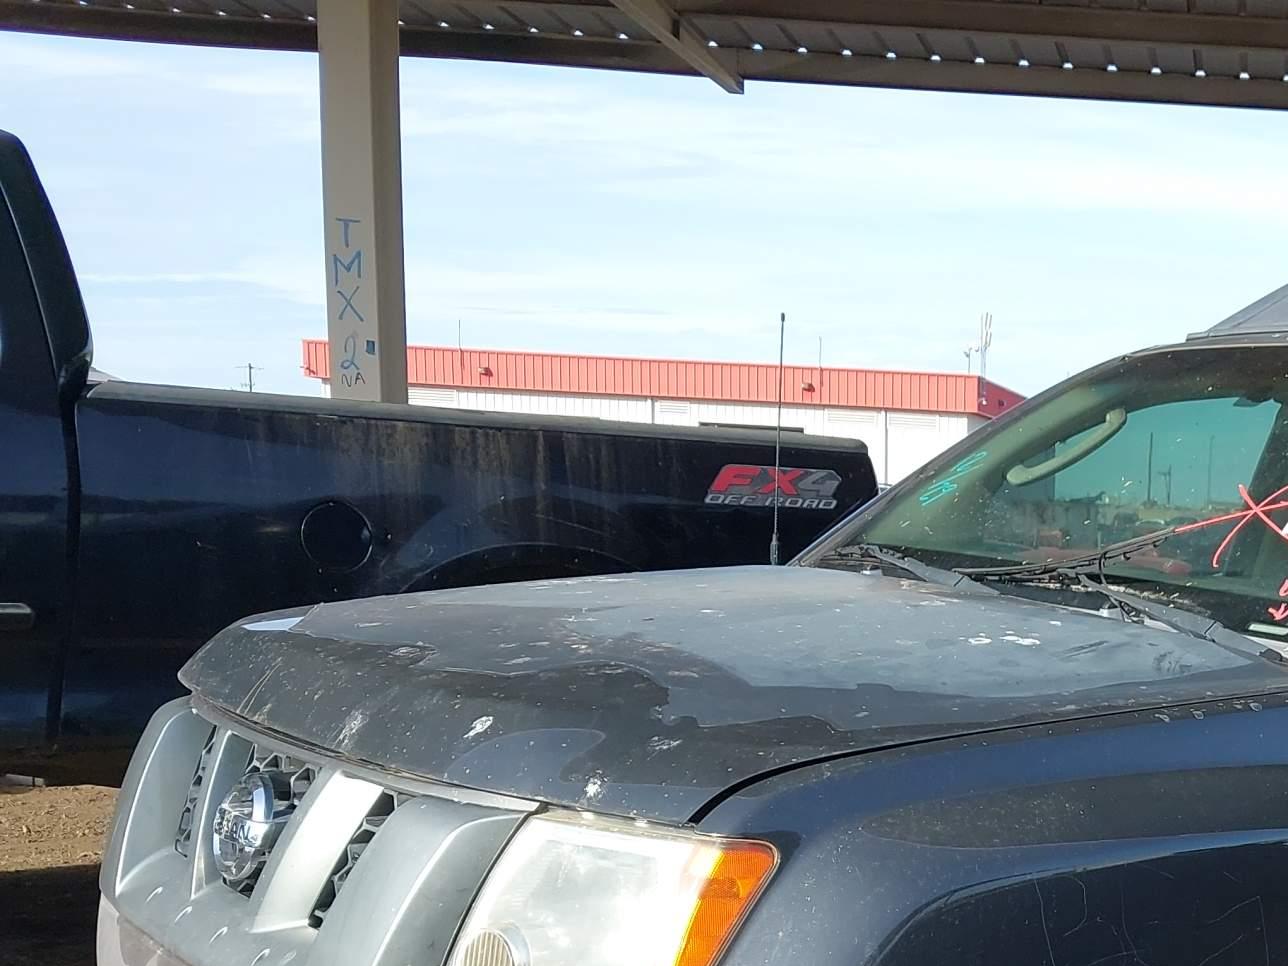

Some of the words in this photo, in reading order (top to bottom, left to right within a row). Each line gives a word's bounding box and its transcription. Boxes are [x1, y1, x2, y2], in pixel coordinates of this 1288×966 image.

[710, 465, 842, 497] FX4
[704, 493, 758, 506] OFF
[764, 496, 839, 510] ROAD
